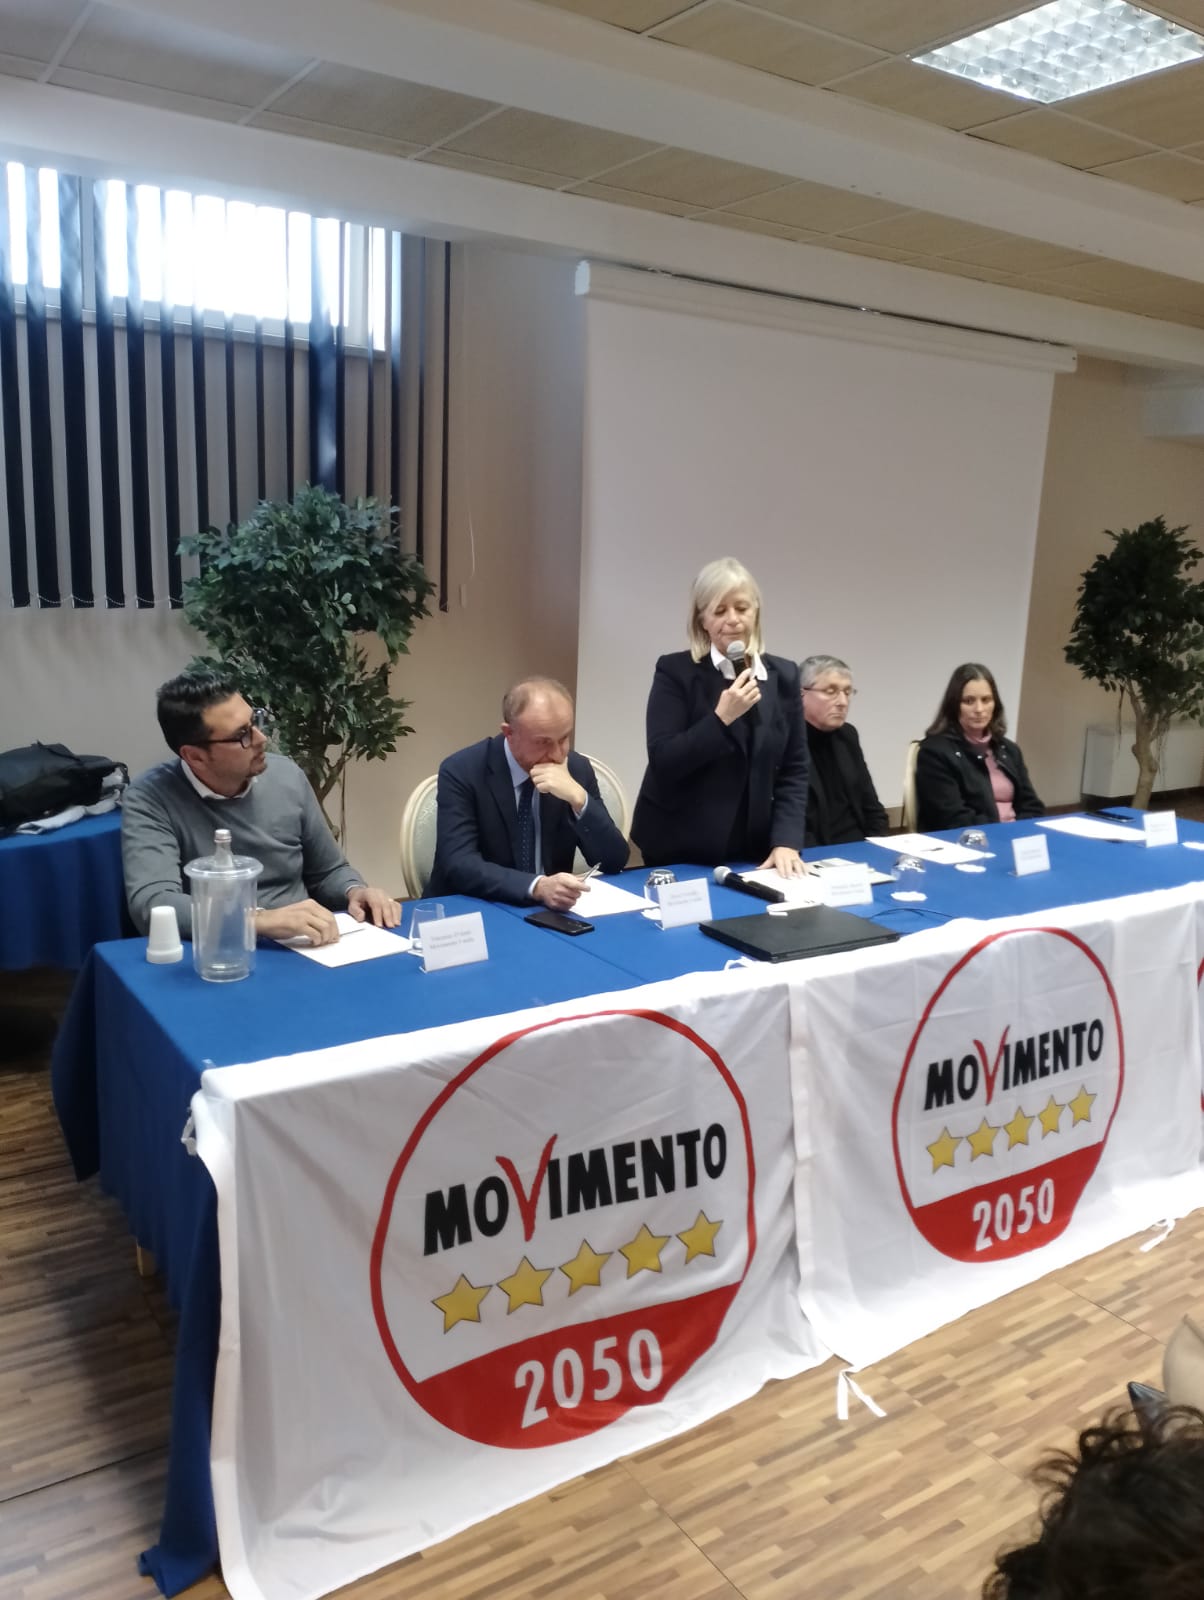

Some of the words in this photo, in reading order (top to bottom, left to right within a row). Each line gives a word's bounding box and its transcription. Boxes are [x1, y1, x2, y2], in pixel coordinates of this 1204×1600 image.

[923, 1018, 1104, 1111] MOVIMENTO
[423, 1122, 727, 1256] MOVIMENTO
[972, 1178, 1055, 1252] 2050
[514, 1328, 663, 1430] 2050
